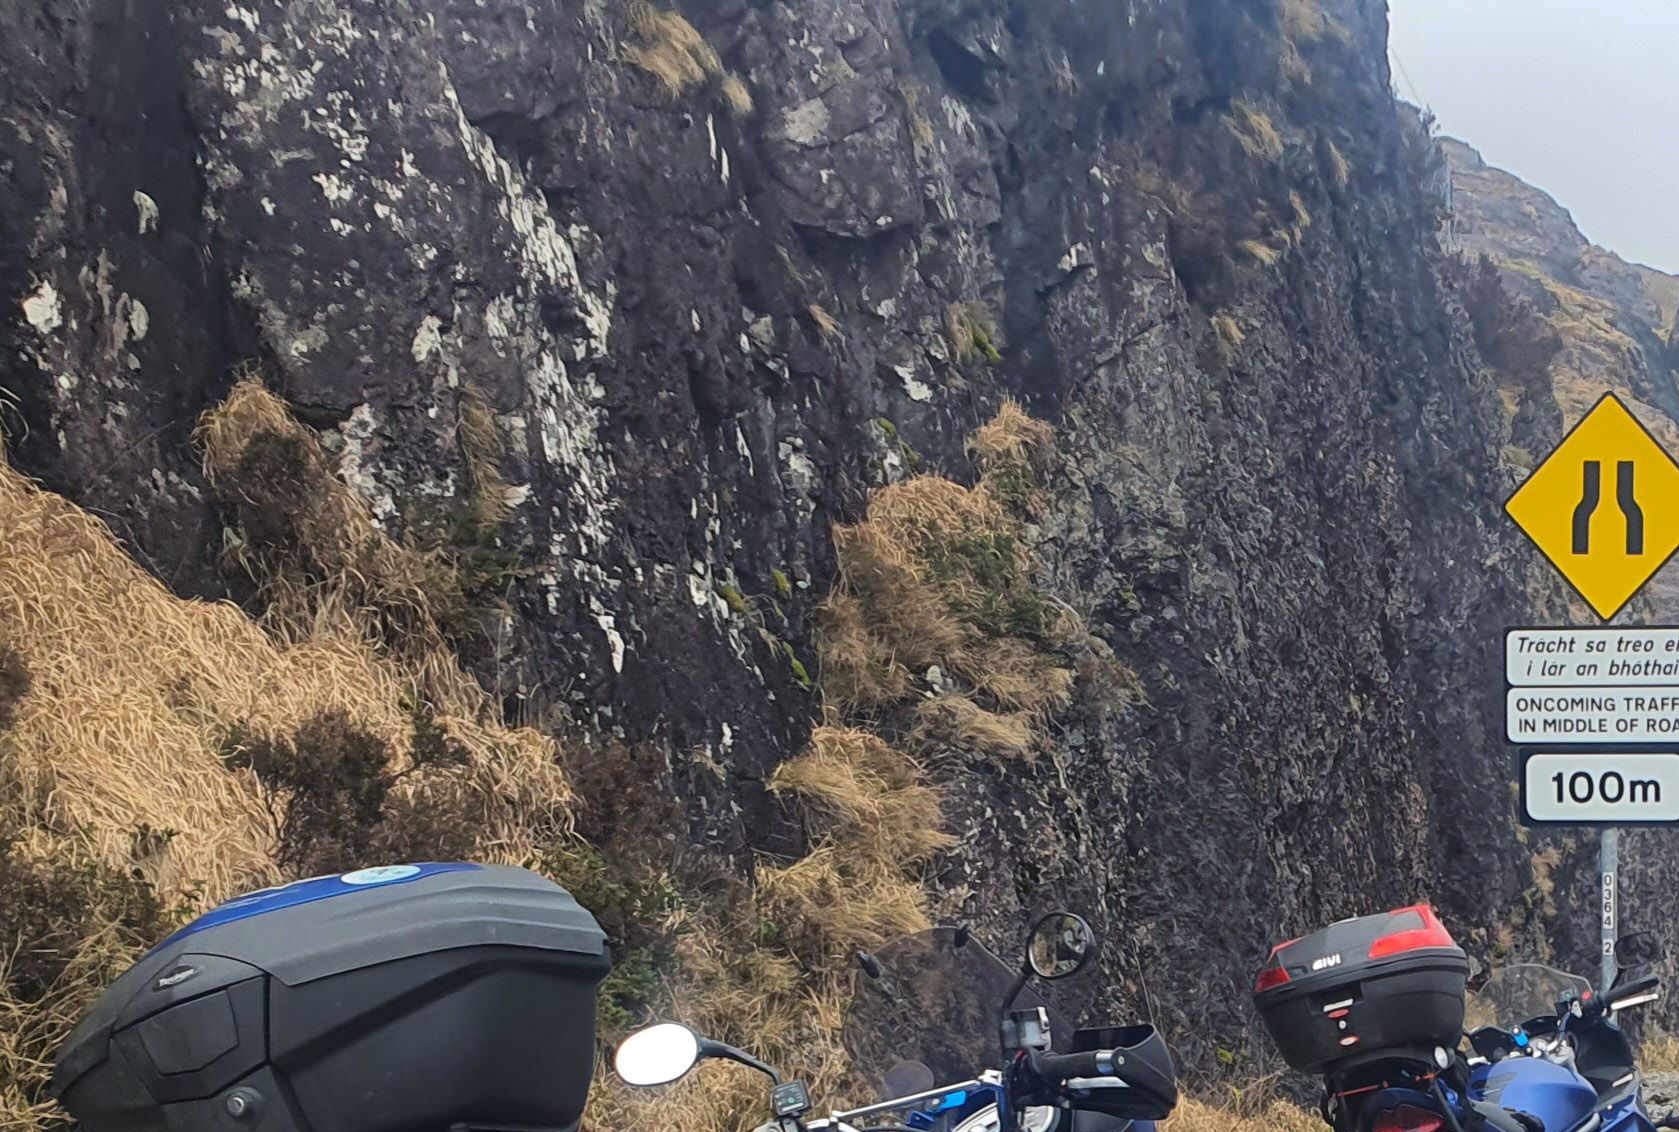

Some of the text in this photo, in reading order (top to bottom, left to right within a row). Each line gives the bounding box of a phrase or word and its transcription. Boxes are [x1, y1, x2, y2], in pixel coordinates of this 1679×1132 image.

[1518, 636, 1576, 654] Trácht
[1585, 639, 1606, 652] sa
[1617, 636, 1654, 652] treo
[1526, 660, 1533, 677] i
[1541, 659, 1567, 677] lár
[1576, 662, 1598, 676] an
[1516, 697, 1616, 712] ONCOMING
[1518, 719, 1536, 733] IN
[1543, 718, 1608, 733] MIDDLE
[1616, 718, 1638, 733] OF
[1552, 771, 1661, 804] 100m
[1604, 942, 1612, 954] 2
[1312, 953, 1341, 971] GIVI
